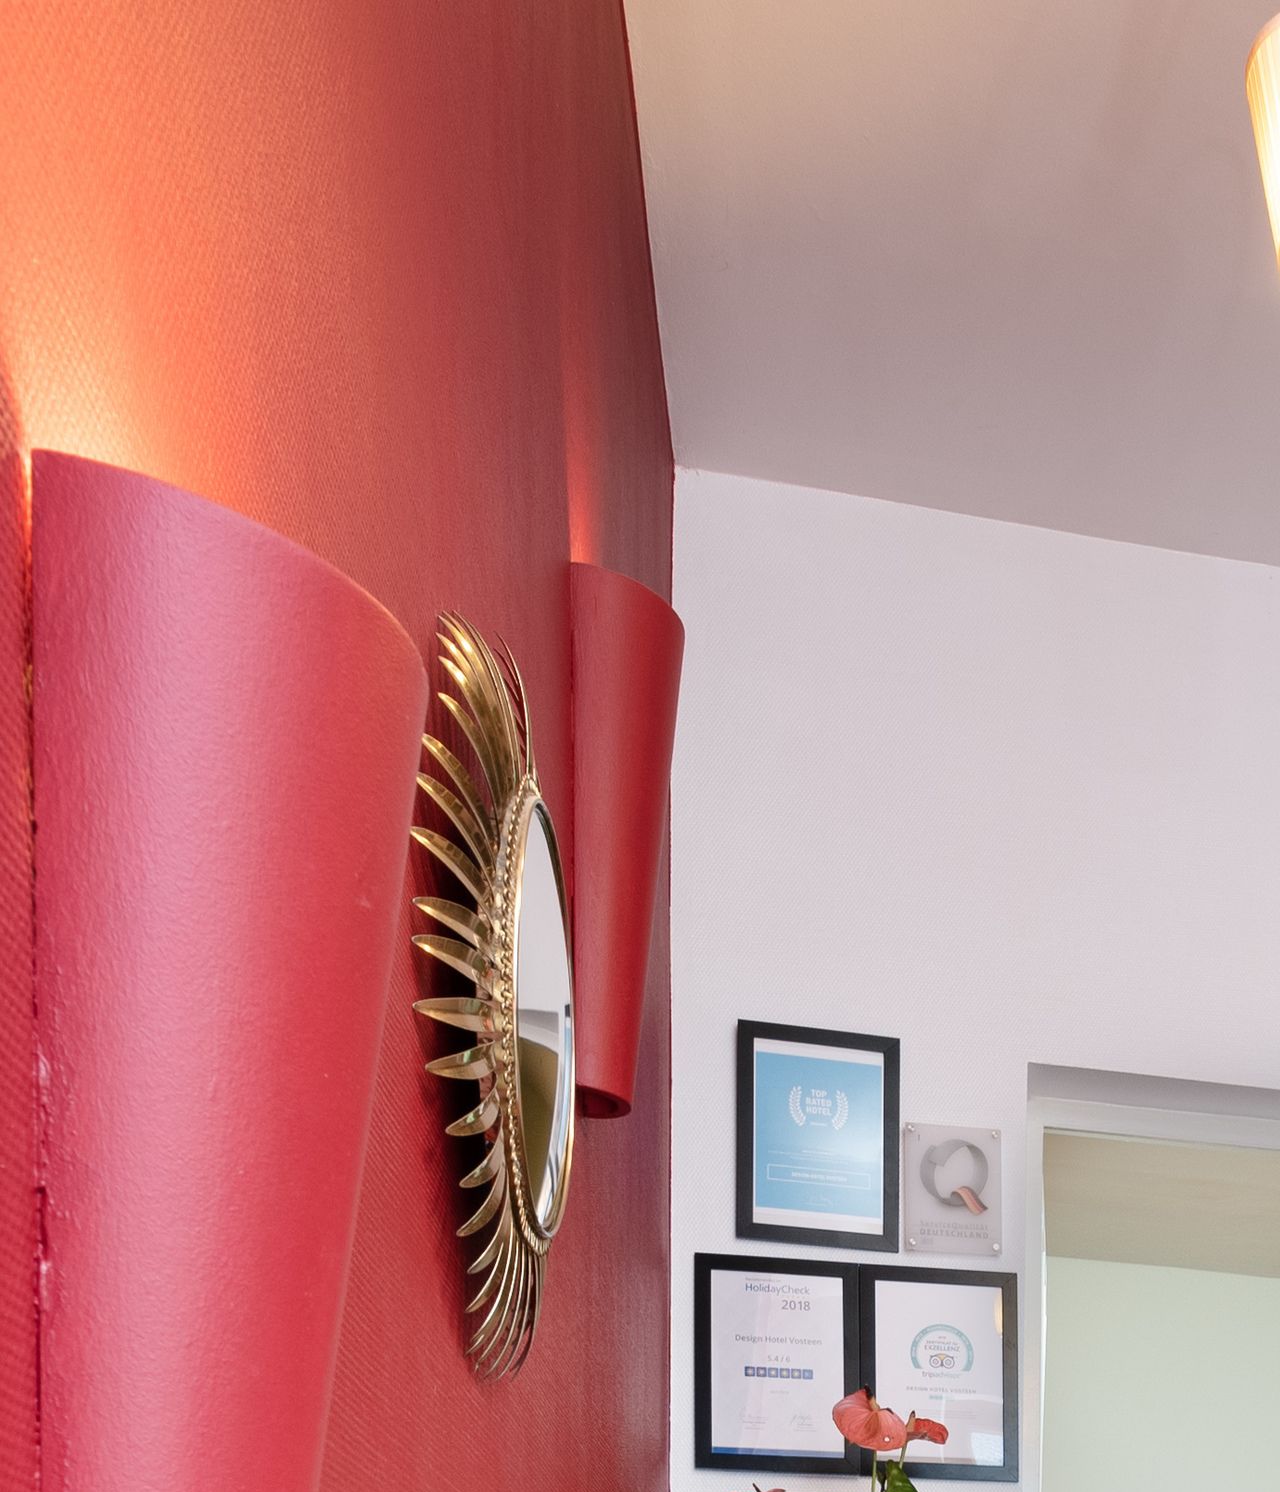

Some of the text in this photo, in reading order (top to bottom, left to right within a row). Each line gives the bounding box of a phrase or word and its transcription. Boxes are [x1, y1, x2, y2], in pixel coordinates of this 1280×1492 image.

[811, 1088, 828, 1098] TOP
[805, 1097, 832, 1107] RATED
[806, 1106, 832, 1117] HOTEL
[919, 1228, 989, 1240] DEUTSCHLAND
[745, 1282, 811, 1297] HolidayCheck
[781, 1299, 811, 1311] 2018
[735, 1333, 823, 1346] Design Hotel Vosteen
